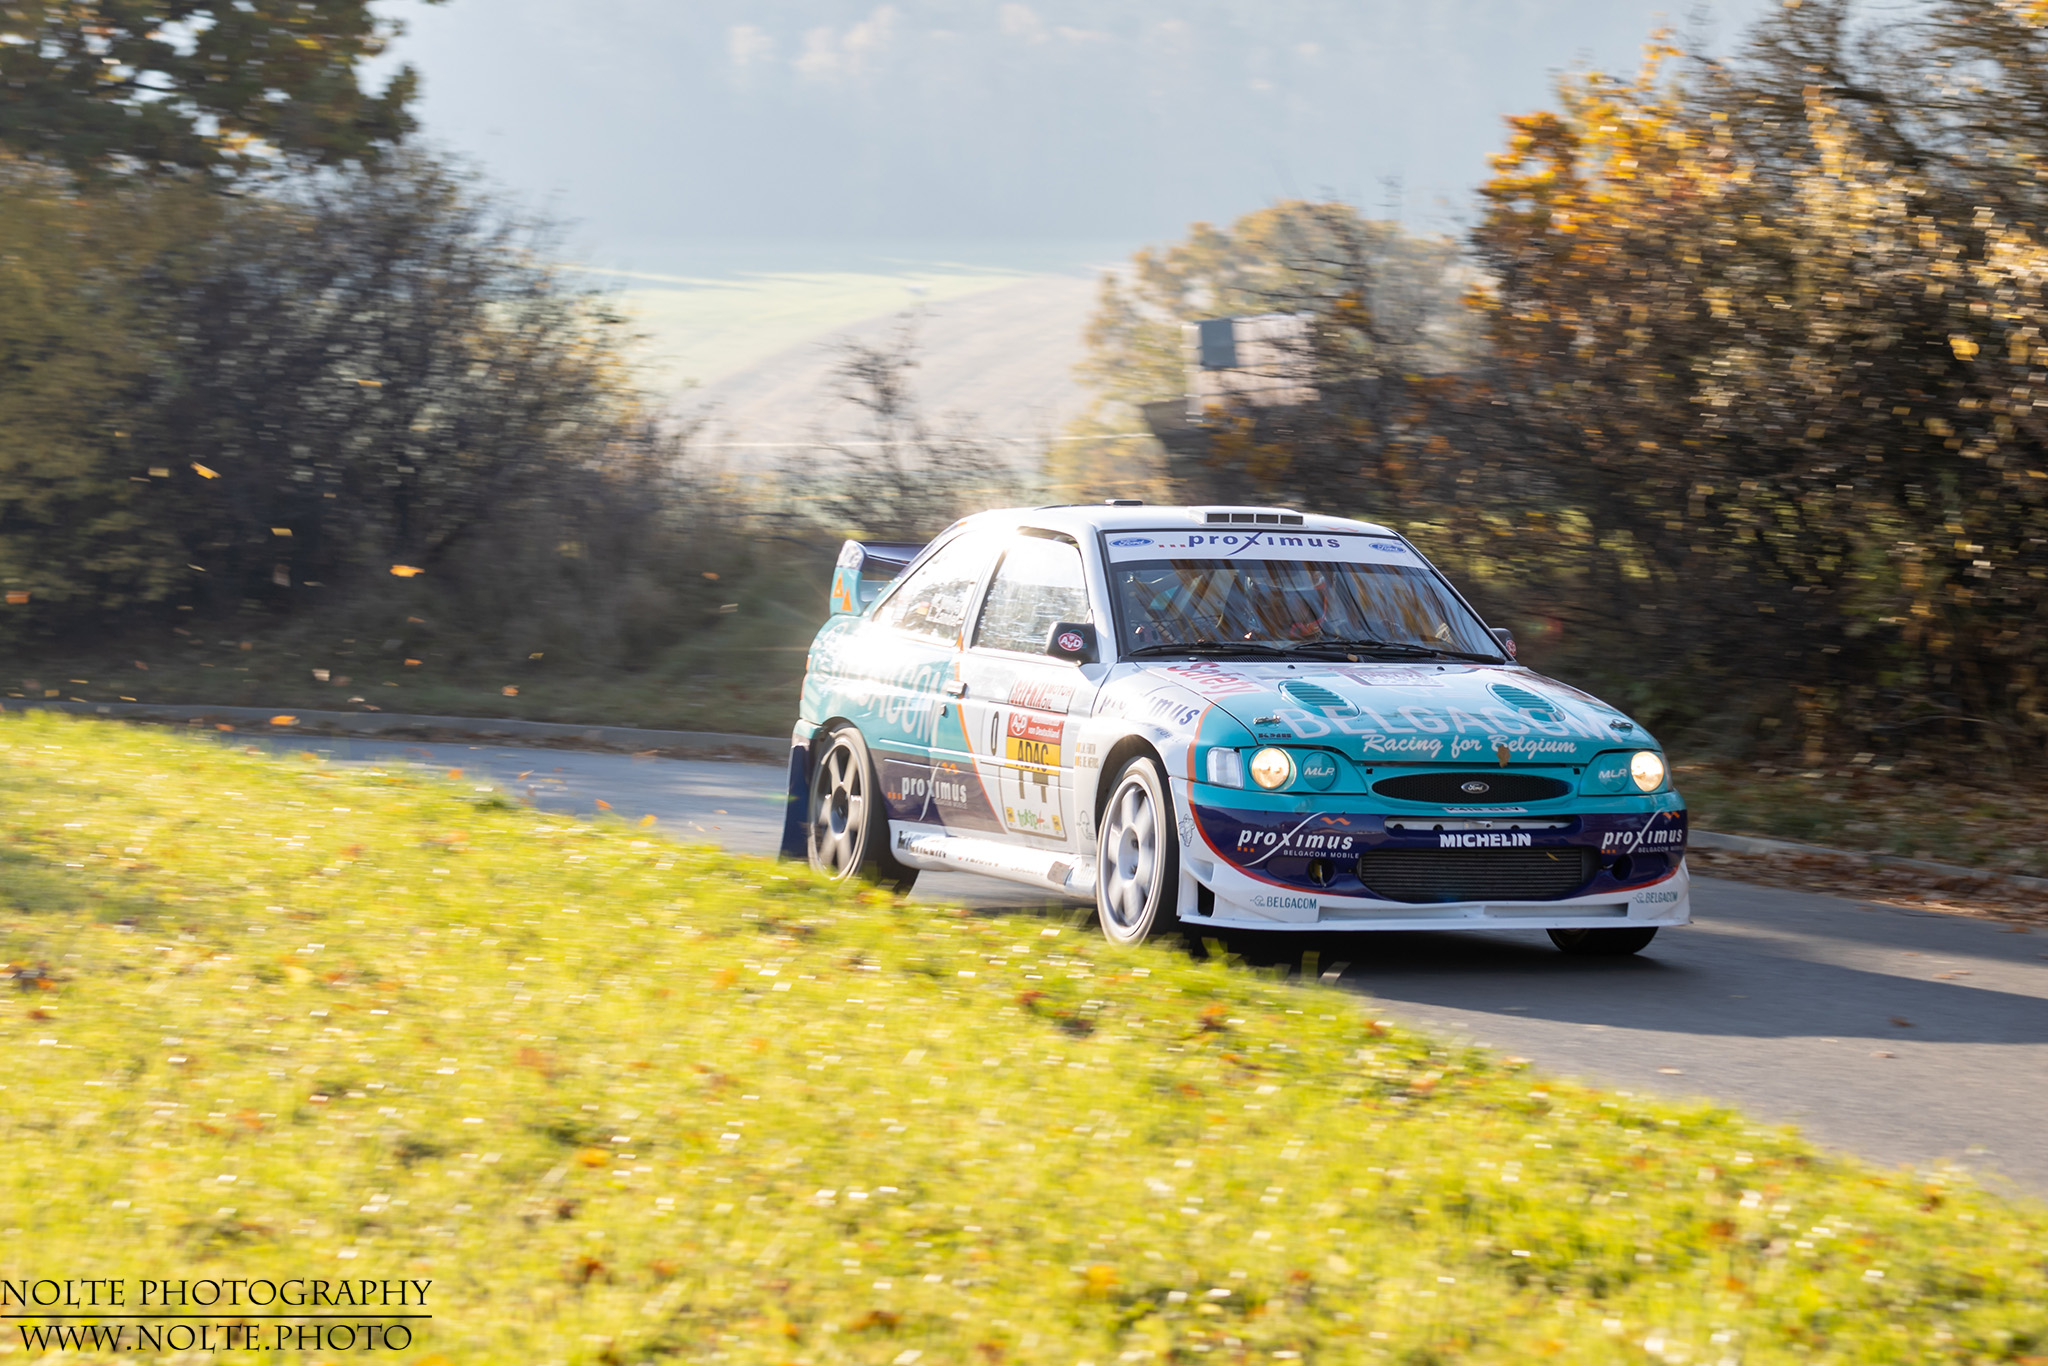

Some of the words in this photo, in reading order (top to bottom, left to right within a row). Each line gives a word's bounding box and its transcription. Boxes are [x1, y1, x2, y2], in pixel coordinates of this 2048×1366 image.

[1113, 538, 1151, 547] Ford
[1167, 662, 1261, 694] Safety
[1273, 705, 1623, 743] BELGACOM
[1016, 740, 1049, 772] ADAC
[1361, 733, 1443, 758] Racing
[1450, 735, 1482, 758] for
[1489, 734, 1577, 759] Belgium
[1439, 833, 1532, 848] MICHELIN
[1283, 850, 1327, 858] BELGACOM
[1330, 851, 1359, 860] MOBILE
[1267, 896, 1317, 909] BELGACOM
